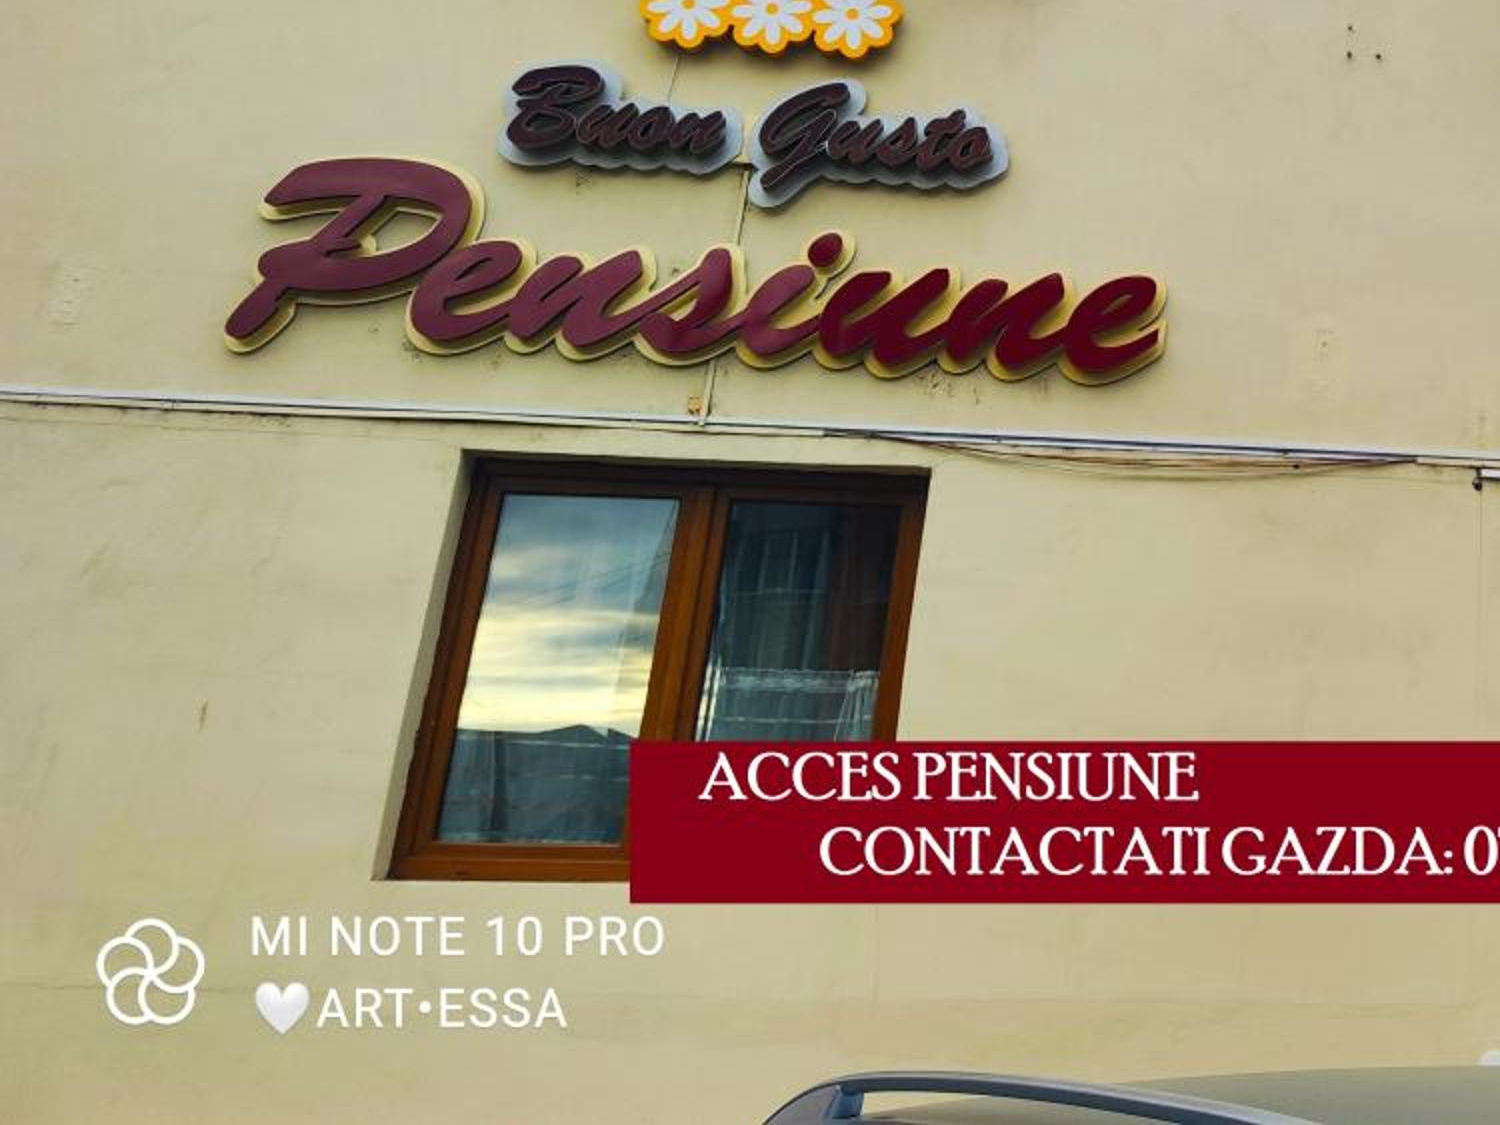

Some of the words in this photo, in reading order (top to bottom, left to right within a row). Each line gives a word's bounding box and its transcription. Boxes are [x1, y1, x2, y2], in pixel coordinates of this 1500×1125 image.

[505, 63, 727, 154] Buon
[757, 81, 994, 192] Gusto
[222, 156, 1162, 376] Pensiune
